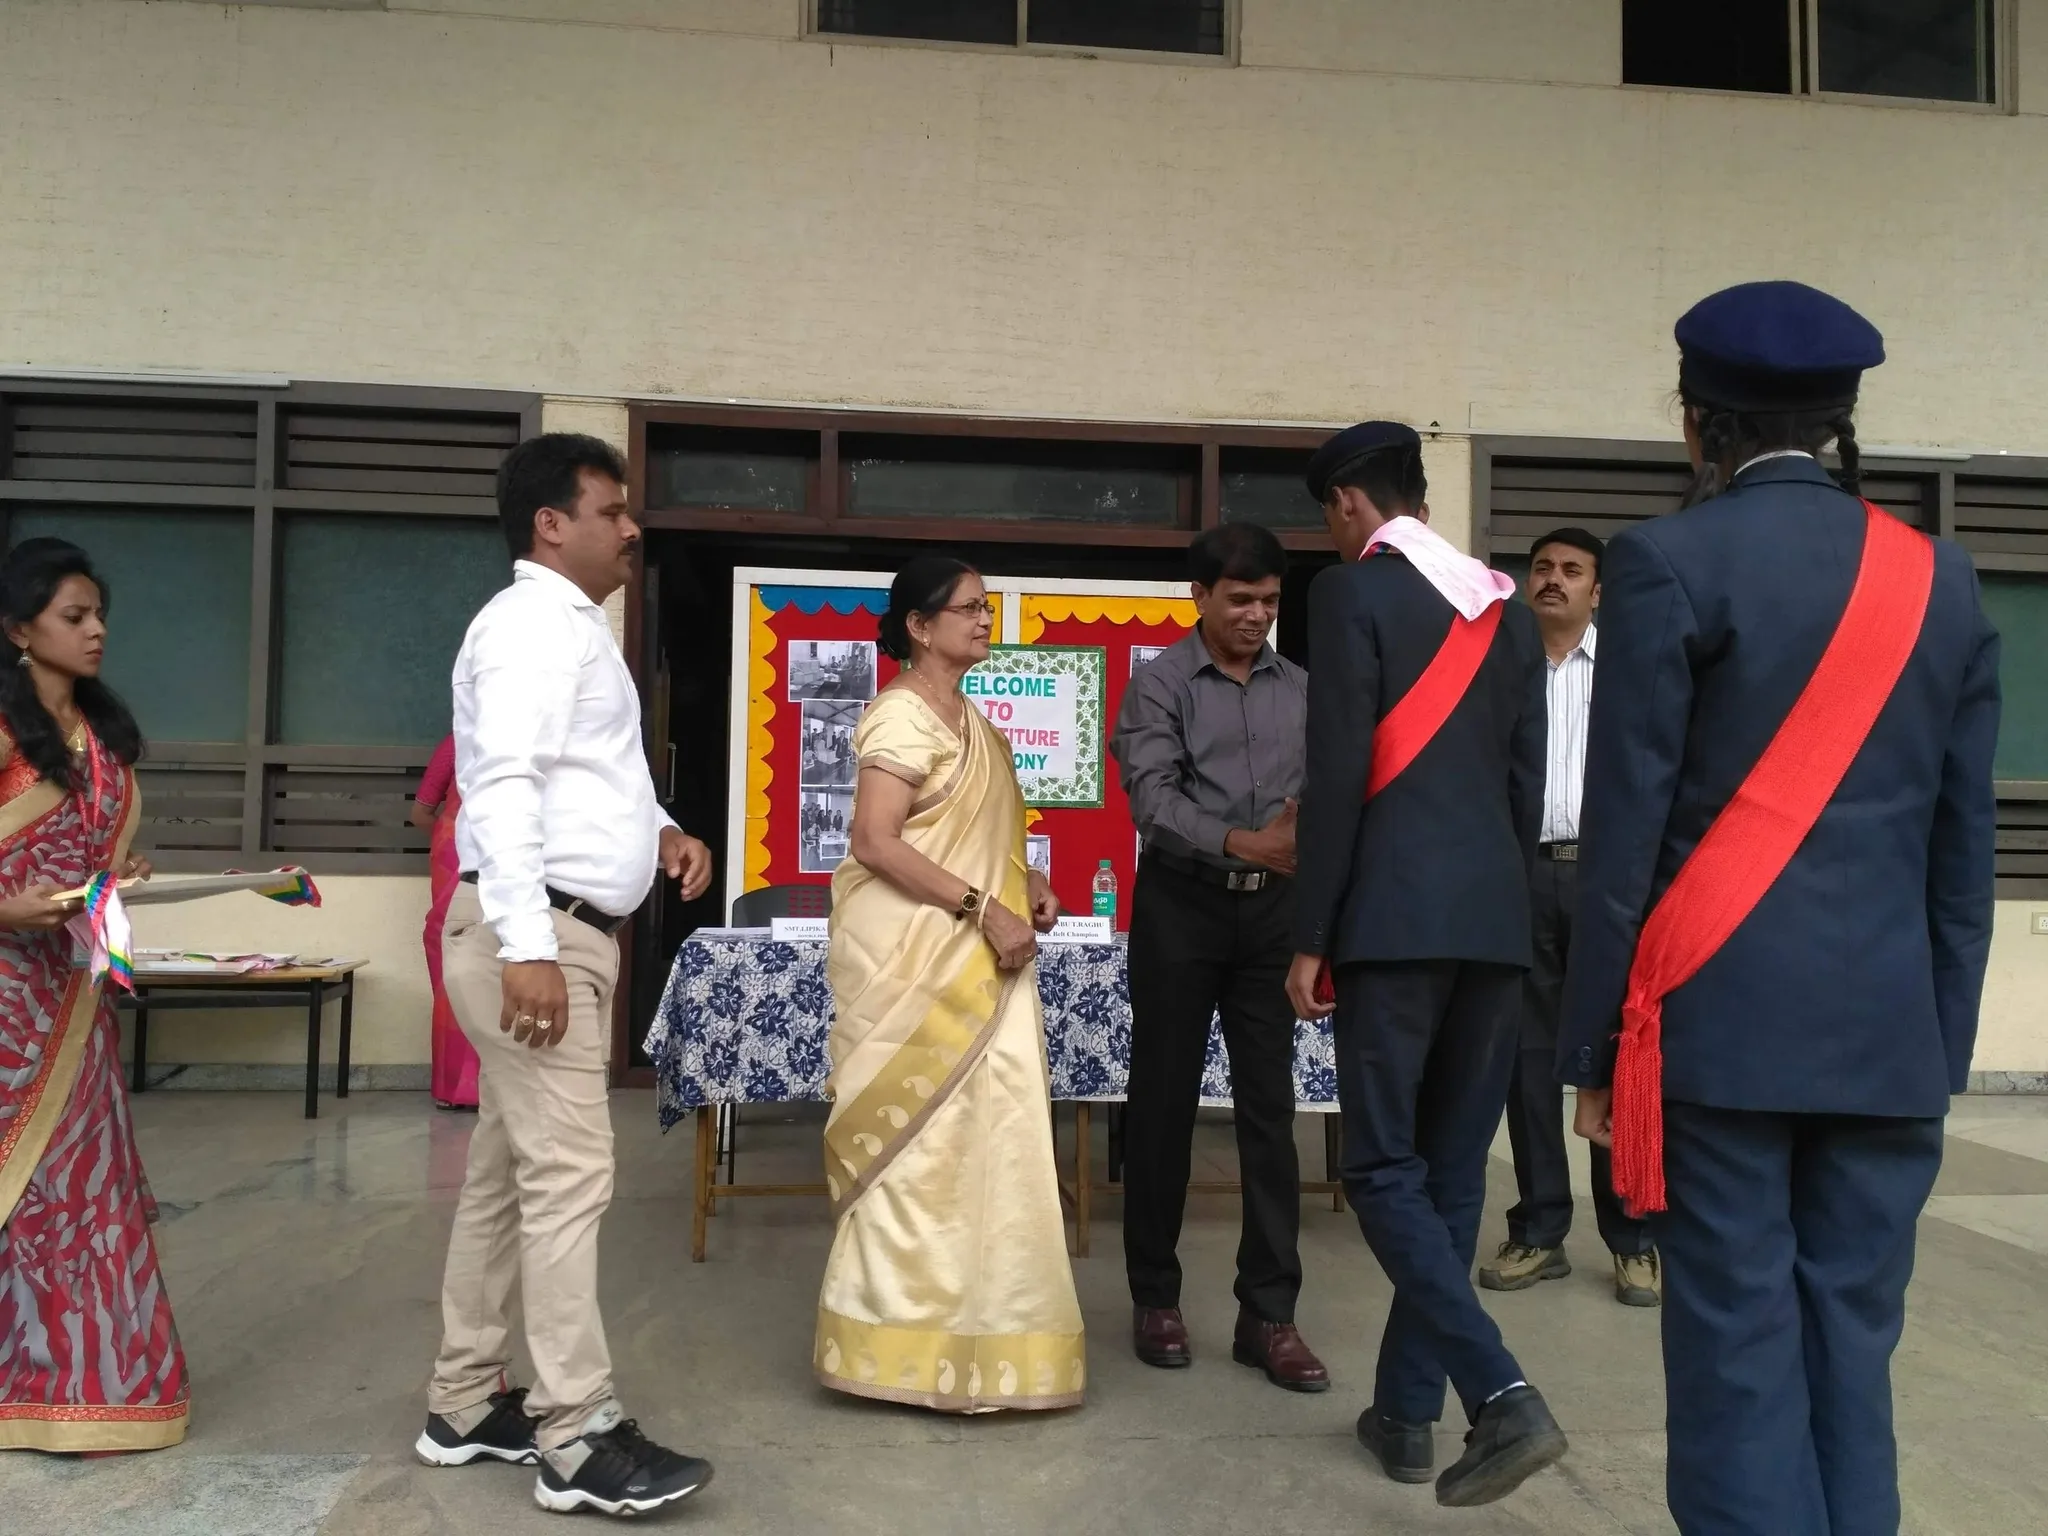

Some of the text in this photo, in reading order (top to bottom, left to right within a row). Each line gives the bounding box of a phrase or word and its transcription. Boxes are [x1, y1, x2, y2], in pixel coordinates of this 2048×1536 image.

[959, 675, 1056, 697] ELCOME
[984, 700, 1013, 721] TO
[998, 728, 1059, 746] TITURE
[1013, 753, 1048, 770] ONY
